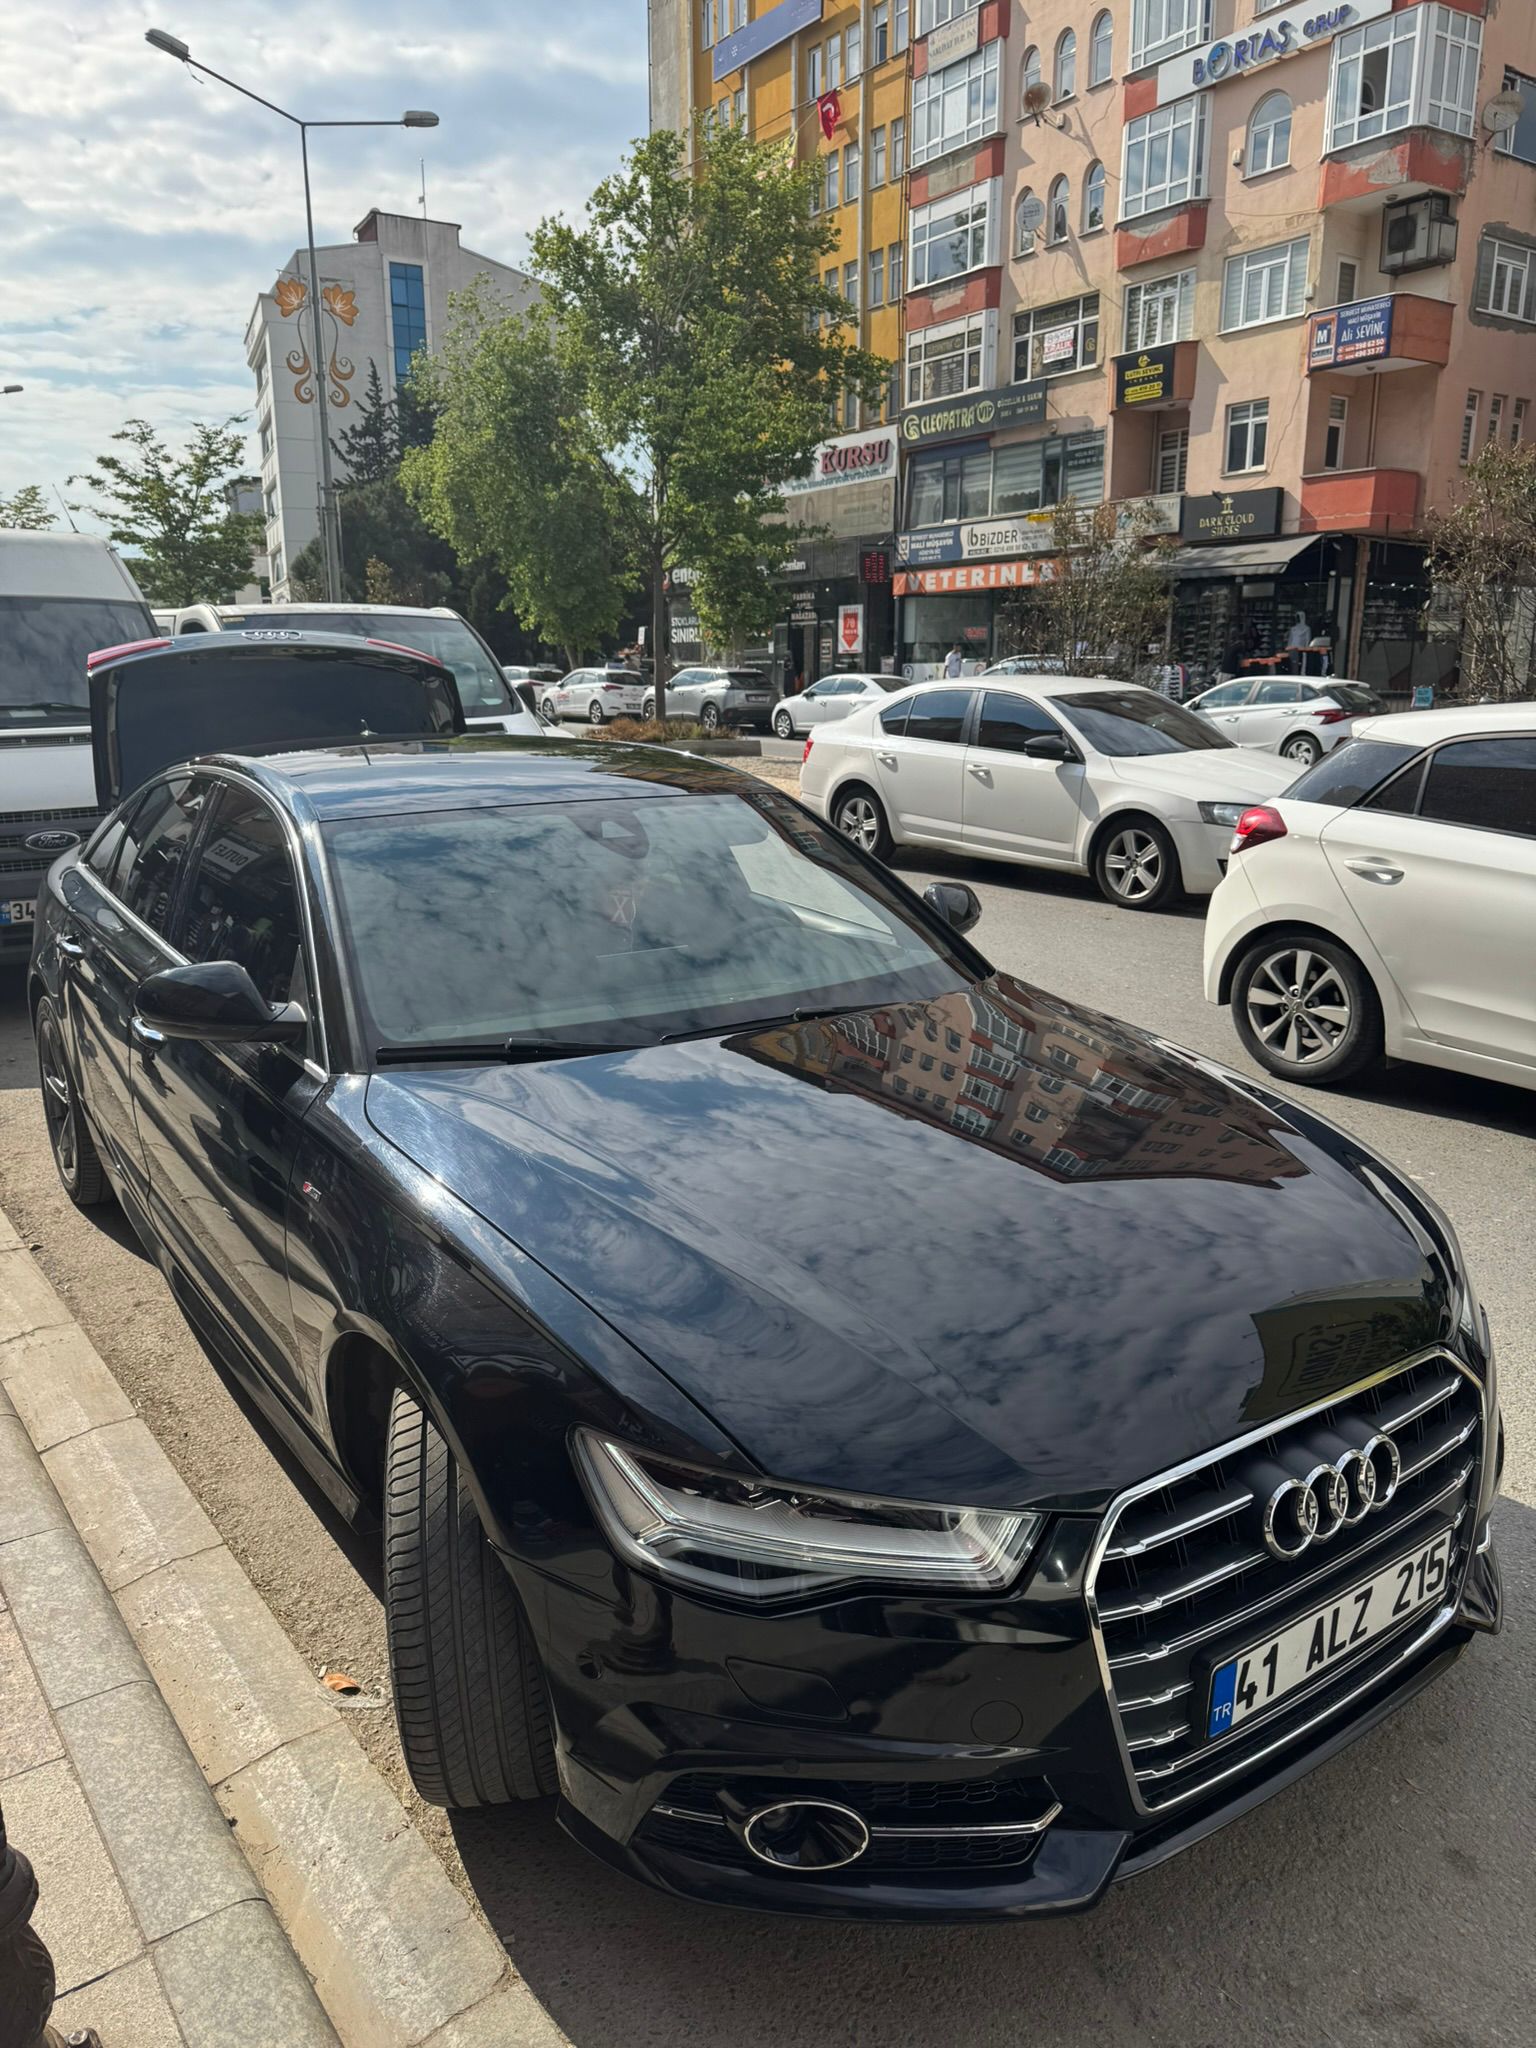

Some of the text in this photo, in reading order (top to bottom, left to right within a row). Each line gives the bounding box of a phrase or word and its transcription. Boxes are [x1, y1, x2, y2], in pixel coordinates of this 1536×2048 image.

[1192, 4, 1353, 85] BORTAŞ GRUP
[921, 406, 975, 434] CLEOPATRA
[979, 405, 993, 420] VIP
[821, 439, 890, 474] KURSU
[1199, 513, 1255, 528] DARK CLOUD
[1211, 524, 1240, 537] SHOES
[38, 833, 69, 847] Ford
[12, 902, 36, 921] 34
[1213, 1539, 1448, 1723] TR 41 ALZ 215
